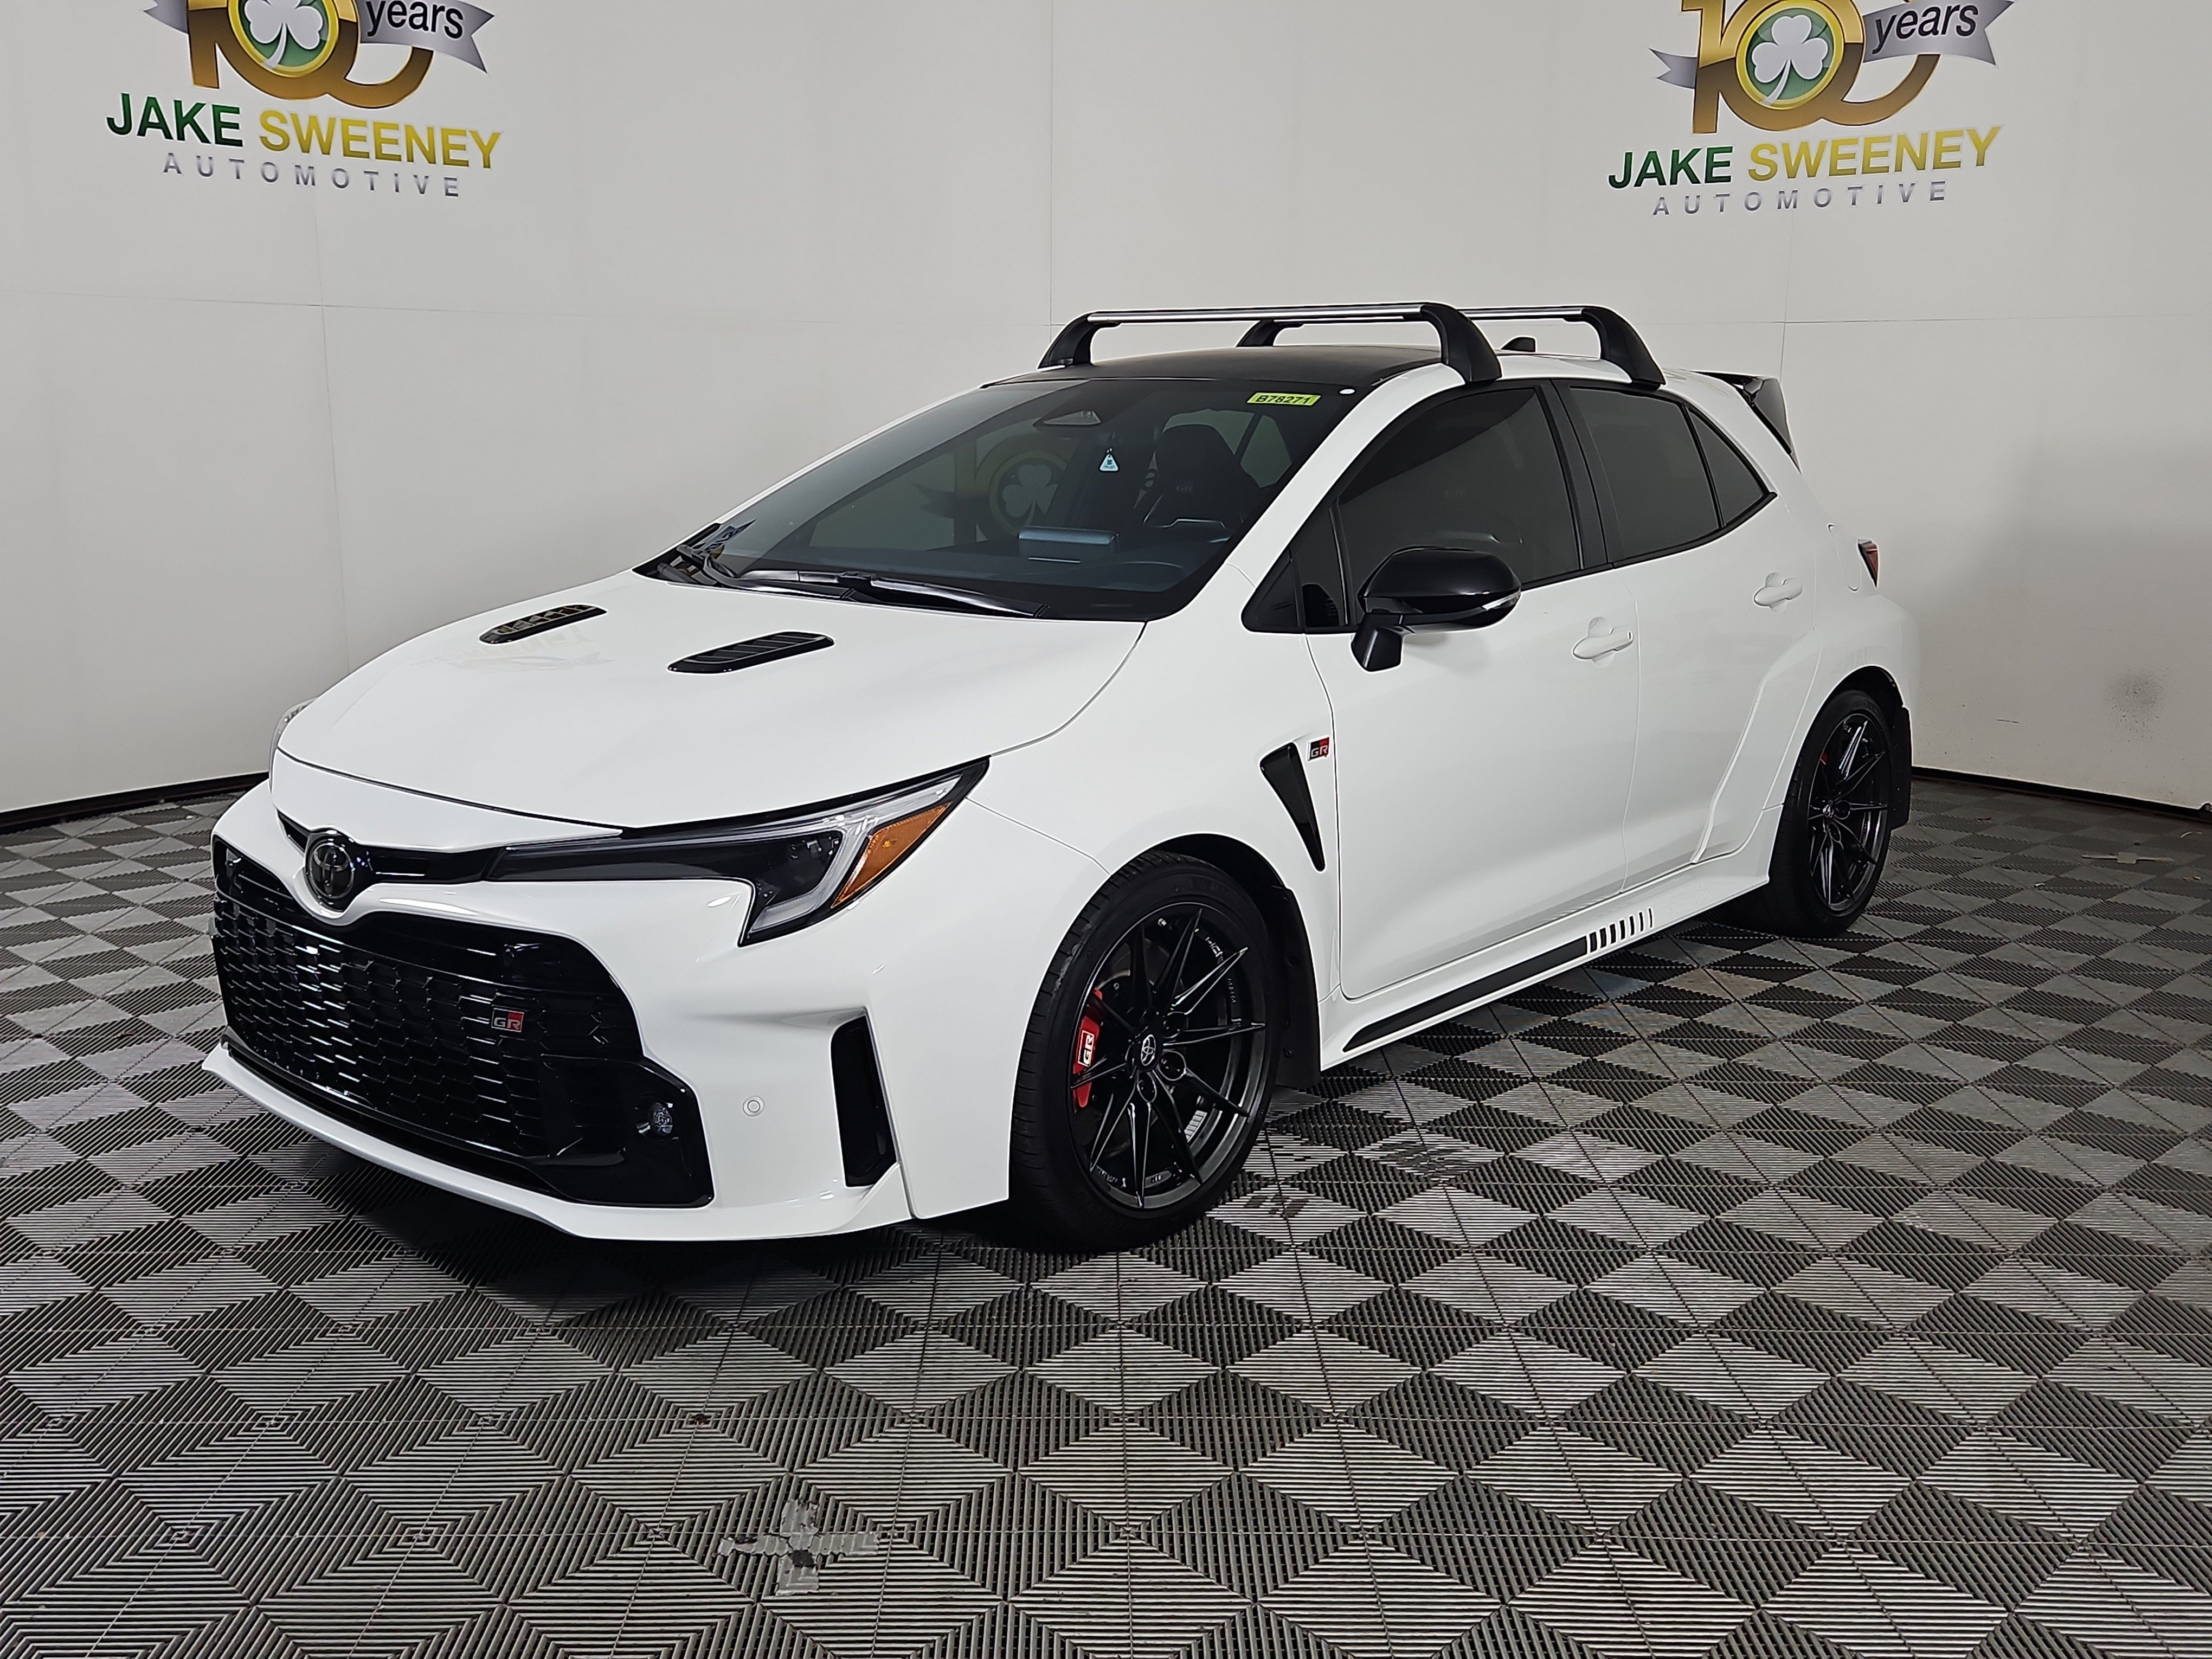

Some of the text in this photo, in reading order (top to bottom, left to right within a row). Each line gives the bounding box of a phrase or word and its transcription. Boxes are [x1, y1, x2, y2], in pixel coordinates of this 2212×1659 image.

[366, 0, 464, 39] years
[1872, 4, 1978, 54] years
[106, 93, 501, 169] JAKE SWEENEY
[163, 152, 459, 197] AUTOMOTIVE
[1608, 126, 2002, 189] JAKE SWEENEY
[1652, 181, 1946, 215] AUTOMOTIVE
[1255, 395, 1311, 404] B78271
[1311, 745, 1328, 757] GR
[494, 1017, 520, 1030] GR
[1083, 1034, 1094, 1065] GR
